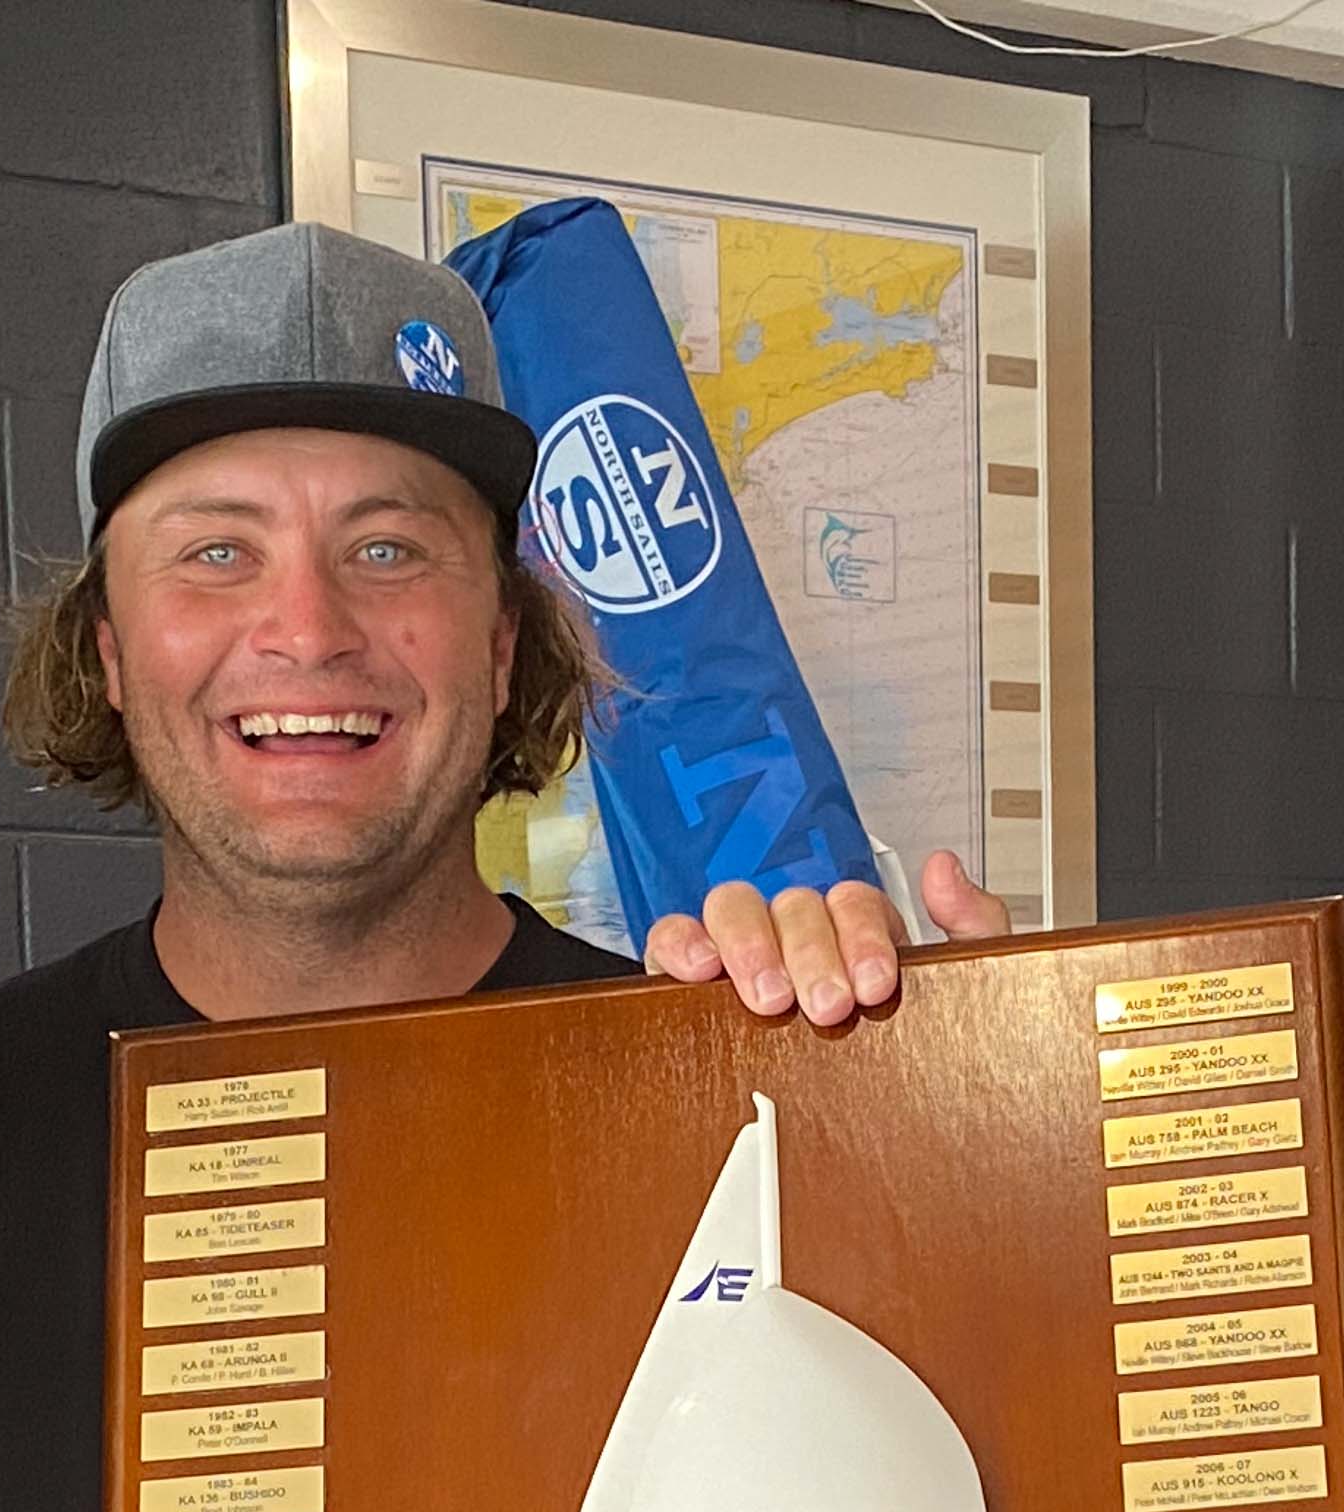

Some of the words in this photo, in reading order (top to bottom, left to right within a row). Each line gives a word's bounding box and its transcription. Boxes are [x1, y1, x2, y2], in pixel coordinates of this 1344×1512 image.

[630, 437, 709, 529] N
[586, 409, 636, 506] NORTH
[630, 512, 672, 597] SAILS
[546, 475, 623, 573] S
[1125, 997, 1152, 1012] AUS
[1187, 987, 1243, 1005] YANDOO
[1246, 985, 1264, 998] XX
[1191, 1055, 1248, 1072] YANDOO
[1250, 1052, 1269, 1066] XX
[220, 1087, 295, 1106] PROJECTILE
[1191, 1125, 1228, 1140] PALM
[1230, 1120, 1278, 1136] BEACH
[231, 1153, 280, 1169] UNREAL
[1145, 1199, 1173, 1213] AUS
[1208, 1191, 1256, 1207] RACER
[219, 1217, 294, 1236] TIDETEASER
[1207, 1329, 1266, 1346] YANDOO
[1269, 1327, 1287, 1340] XX
[1159, 1408, 1188, 1422] AUS
[1232, 1399, 1280, 1415] TANGO
[231, 1418, 277, 1433] IMPALA
[1216, 1469, 1285, 1487] KOOLONG
[229, 1486, 286, 1502] BUSHIDO
